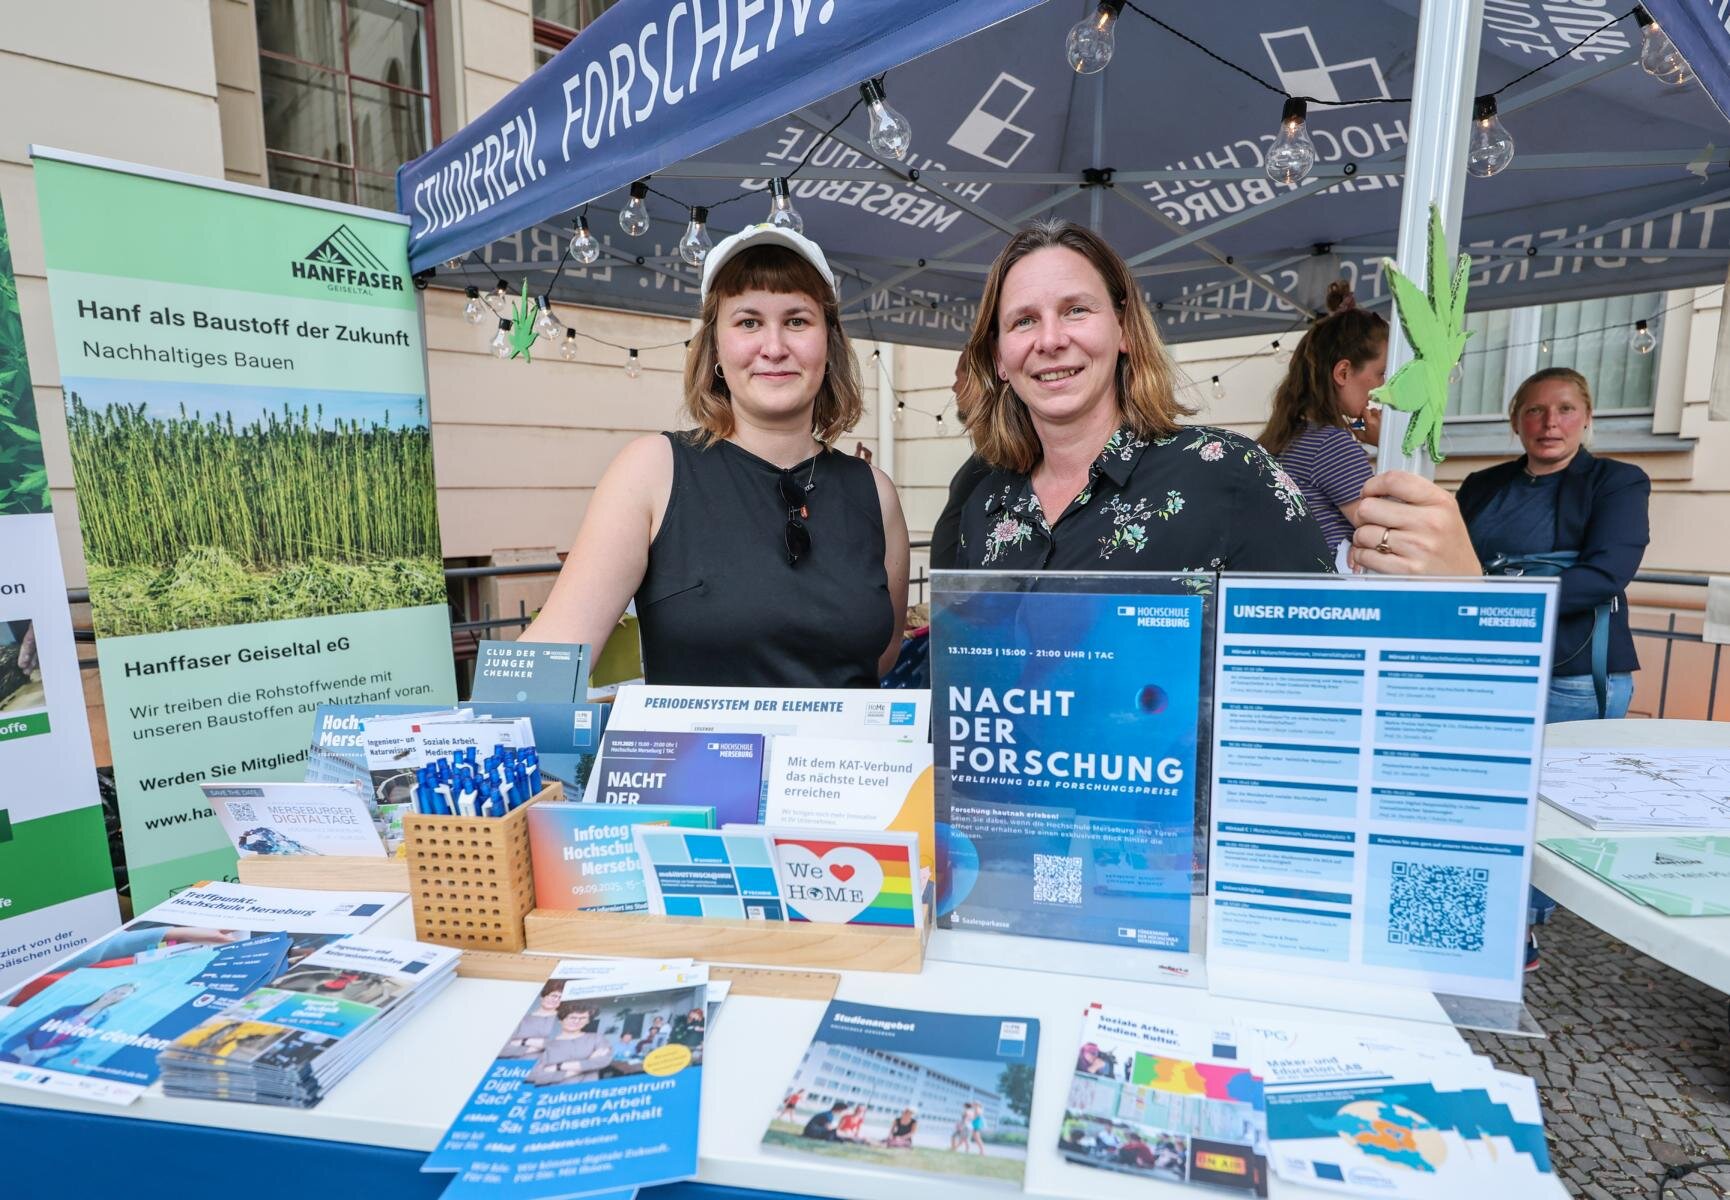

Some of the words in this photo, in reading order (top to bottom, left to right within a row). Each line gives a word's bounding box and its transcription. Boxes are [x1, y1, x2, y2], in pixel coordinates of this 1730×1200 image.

[415, 108, 546, 240] STUDIEREN.
[562, 0, 836, 162] FORSCHEN.
[291, 261, 404, 292] HANFFASER
[327, 284, 373, 296] GEISELTAL
[78, 300, 141, 323] Hanf
[150, 307, 186, 328] als
[194, 311, 289, 337] Baustoff
[296, 322, 330, 340] der
[336, 325, 410, 347] Zukunft
[83, 341, 228, 368] Nachhaltiges
[234, 352, 295, 370] Bauen
[0, 582, 26, 596] on
[1137, 607, 1190, 617] HOCHSCHULE
[1233, 605, 1285, 619] UNSER
[1287, 607, 1381, 621] PROGRAMM
[1479, 607, 1537, 617] HOCHSCHULE
[1137, 617, 1190, 628] MERSEBURG
[1478, 617, 1537, 628] MERSEBURG
[124, 651, 231, 678] Hanffaser
[238, 640, 321, 663] Geiseltal
[326, 637, 350, 652] eG
[486, 649, 512, 657] CLUB
[948, 647, 993, 656] 13.11.2025
[1001, 648, 1026, 657] 15:00
[1036, 649, 1061, 658] 21:00
[1064, 650, 1085, 659] UHR
[1095, 651, 1114, 660] TAC
[484, 659, 534, 668] JUNGEN
[483, 670, 533, 678] CHEMIKER
[130, 704, 160, 720] Wir
[164, 695, 223, 716] treiben
[227, 689, 251, 705] die
[255, 674, 367, 700] Rohstoffwende
[370, 671, 392, 685] mit
[949, 686, 1075, 717] NACHT
[133, 722, 202, 741] unseren
[207, 706, 293, 729] Baustoffen
[298, 700, 324, 715] aus
[328, 688, 391, 709] Nutzhanf
[395, 682, 434, 698] voran.
[644, 697, 750, 711] PERIODENSYSTEM
[753, 700, 777, 712] DER
[782, 701, 844, 713] ELEMENTE
[0, 721, 28, 736] offe
[323, 714, 359, 730] Hoch
[949, 716, 1016, 744] DER
[320, 732, 364, 748] Merse
[367, 738, 404, 748] Ingenieur-
[405, 736, 416, 744] un
[423, 738, 450, 746] Soziale
[452, 737, 478, 745] Arbeit.
[720, 743, 753, 751] HOCHSCHULE
[370, 746, 417, 756] Naturwissens
[425, 749, 453, 757] Medien
[139, 770, 207, 792] Werden
[211, 763, 238, 779] Sie
[241, 749, 309, 774] Mitglied!
[787, 757, 807, 768] Mit
[810, 758, 836, 769] dem
[839, 759, 913, 774] KAT-Verbund
[949, 745, 1184, 784] FORSCHUNG
[607, 771, 667, 789] NACHT
[785, 771, 806, 782] das
[809, 773, 855, 785] nächste
[858, 776, 889, 787] Level
[951, 775, 1023, 786] VERLEIHUNG
[1027, 779, 1050, 788] DER
[1055, 781, 1179, 797] FORSCHUNGSPREISE
[605, 791, 640, 806] DER
[784, 787, 841, 799] erreichen
[267, 806, 353, 815] MERSEBURGER
[950, 806, 991, 816] Forschung
[992, 809, 1025, 818] hautnah
[1026, 811, 1059, 820] erleben!
[273, 814, 359, 824] DIGITALTAGE
[1009, 819, 1031, 827] wenn
[1031, 819, 1045, 828] die
[1046, 821, 1091, 831] Hochschule
[1092, 824, 1134, 835] Merseburg
[574, 825, 629, 843] Infotag
[974, 824, 989, 832] und
[1037, 829, 1059, 837] einen
[563, 842, 635, 861] Hochschu
[581, 857, 643, 876] Mersebu
[785, 862, 823, 879] We
[185, 891, 257, 905] Treffpunkt:
[171, 898, 250, 911] Hochschule
[248, 904, 317, 917] Merseburg
[962, 917, 1010, 928] Saalesparkasse
[0, 943, 26, 959] ziert
[30, 937, 52, 949] von
[55, 930, 74, 942] der
[0, 949, 51, 970] äischen
[54, 937, 88, 953] Union
[38, 1018, 98, 1039] Weiter
[833, 1013, 915, 1032] Studienangebot
[1099, 1015, 1138, 1029] Soziale
[1140, 1023, 1178, 1036] Arbeit.
[1097, 1024, 1141, 1039] Medien.
[1143, 1033, 1180, 1047] Kultur.
[492, 1065, 532, 1079] Zuku
[483, 1079, 524, 1093] Digit
[536, 1079, 677, 1106] Zukunftszentrum
[533, 1101, 598, 1120] Digitale
[600, 1095, 652, 1112] Arbeit
[528, 1107, 663, 1135] Sachsen-Anhalt
